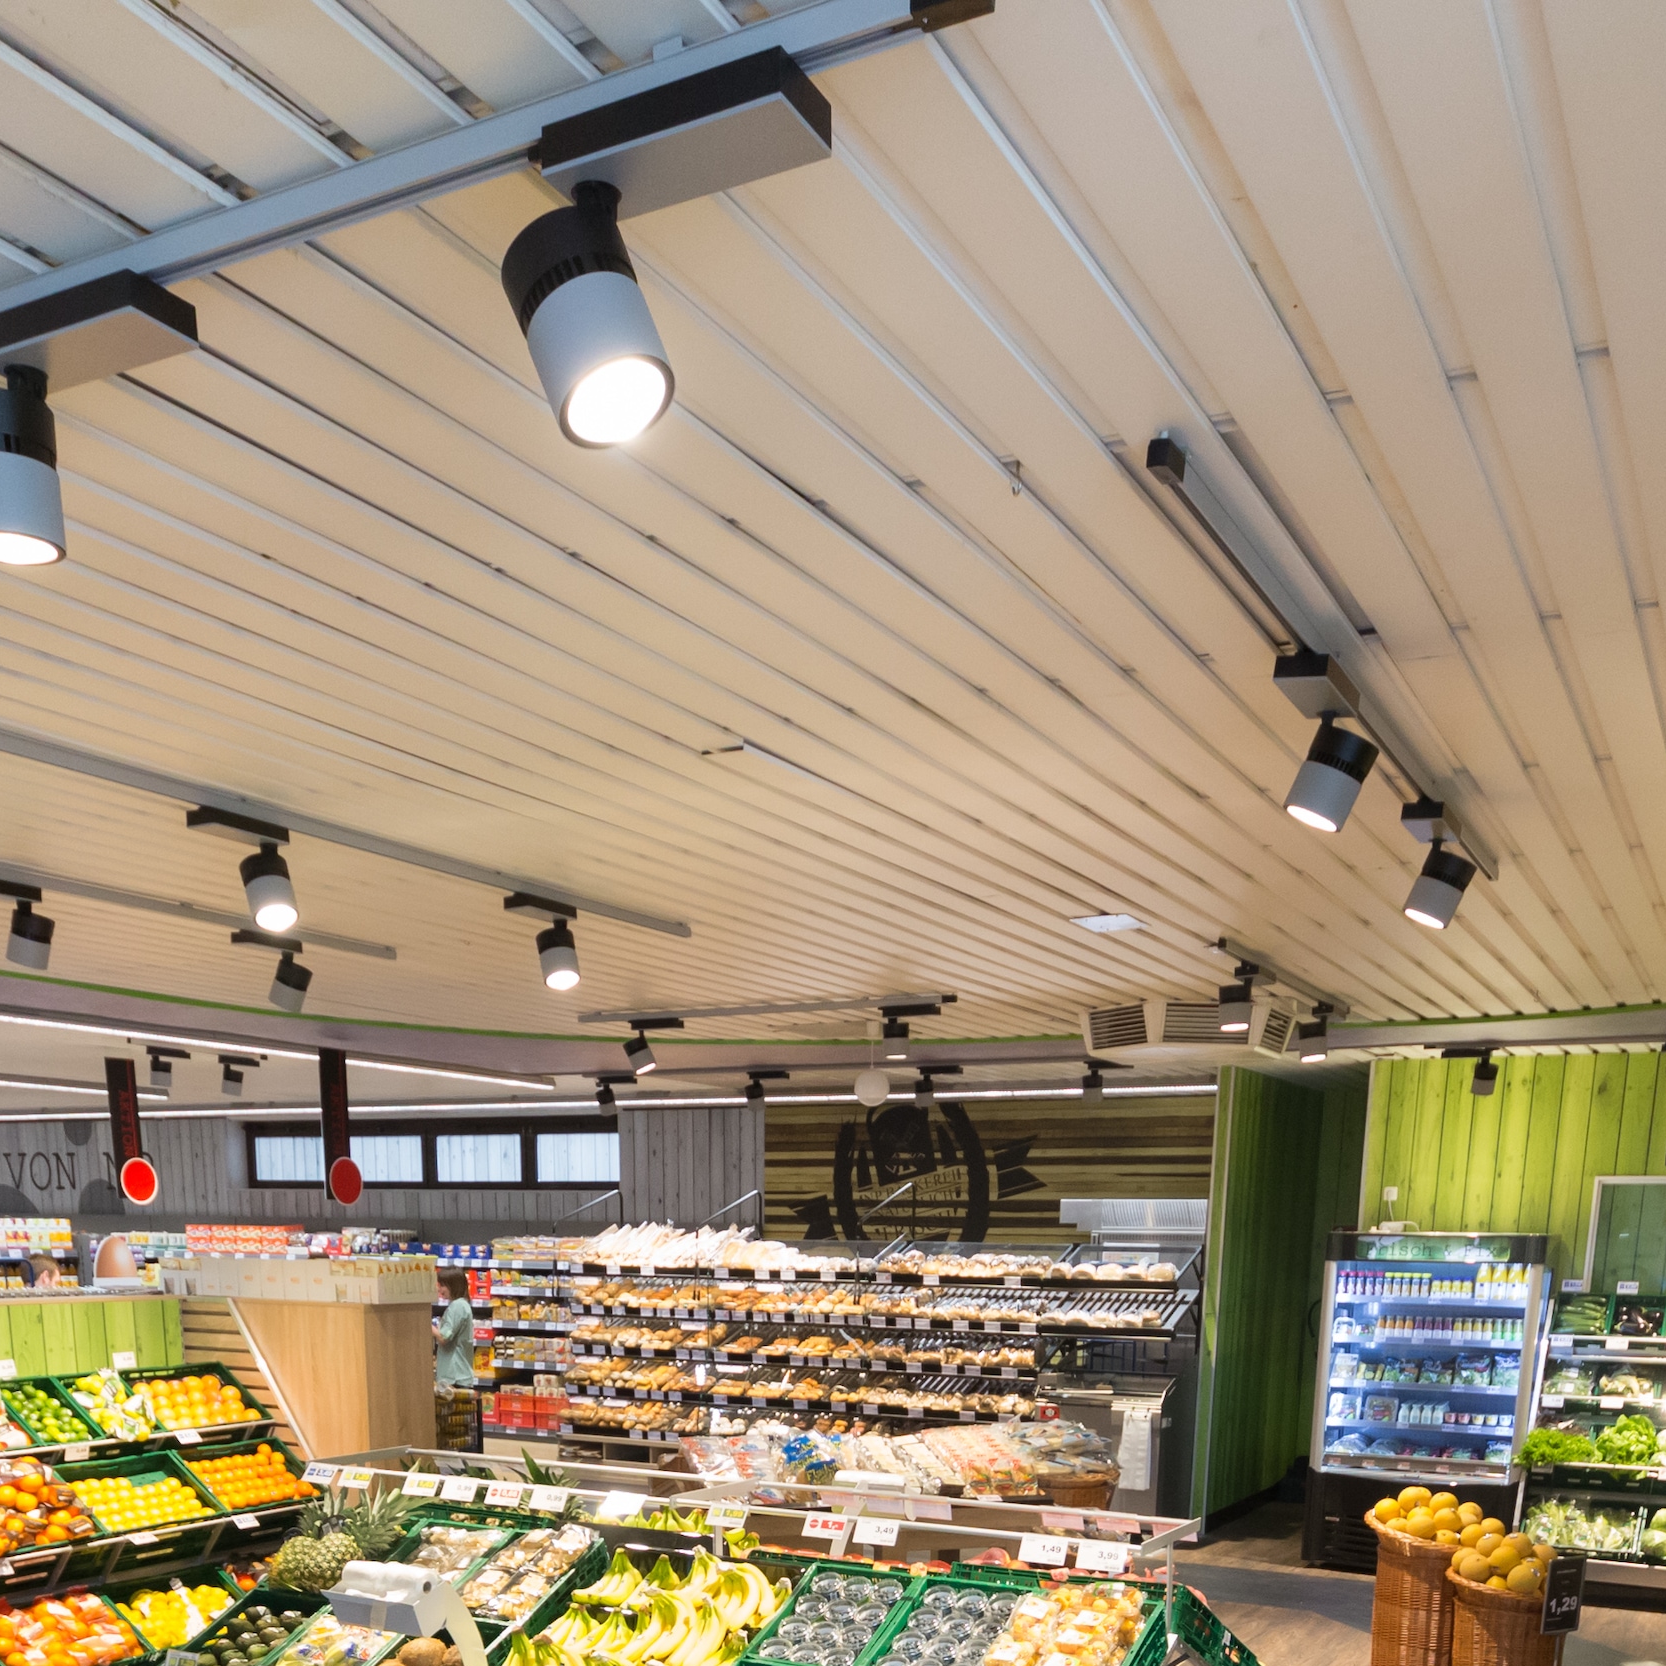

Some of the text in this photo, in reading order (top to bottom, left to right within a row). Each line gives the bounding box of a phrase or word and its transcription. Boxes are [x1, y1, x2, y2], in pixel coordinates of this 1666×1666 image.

[3, 1152, 76, 1191] VON
[1367, 1241, 1432, 1257] Frisch
[1464, 1244, 1499, 1257] Fix
[875, 1526, 894, 1535] 3,49
[1042, 1544, 1062, 1554] 1,49
[1098, 1551, 1118, 1561] 3,99
